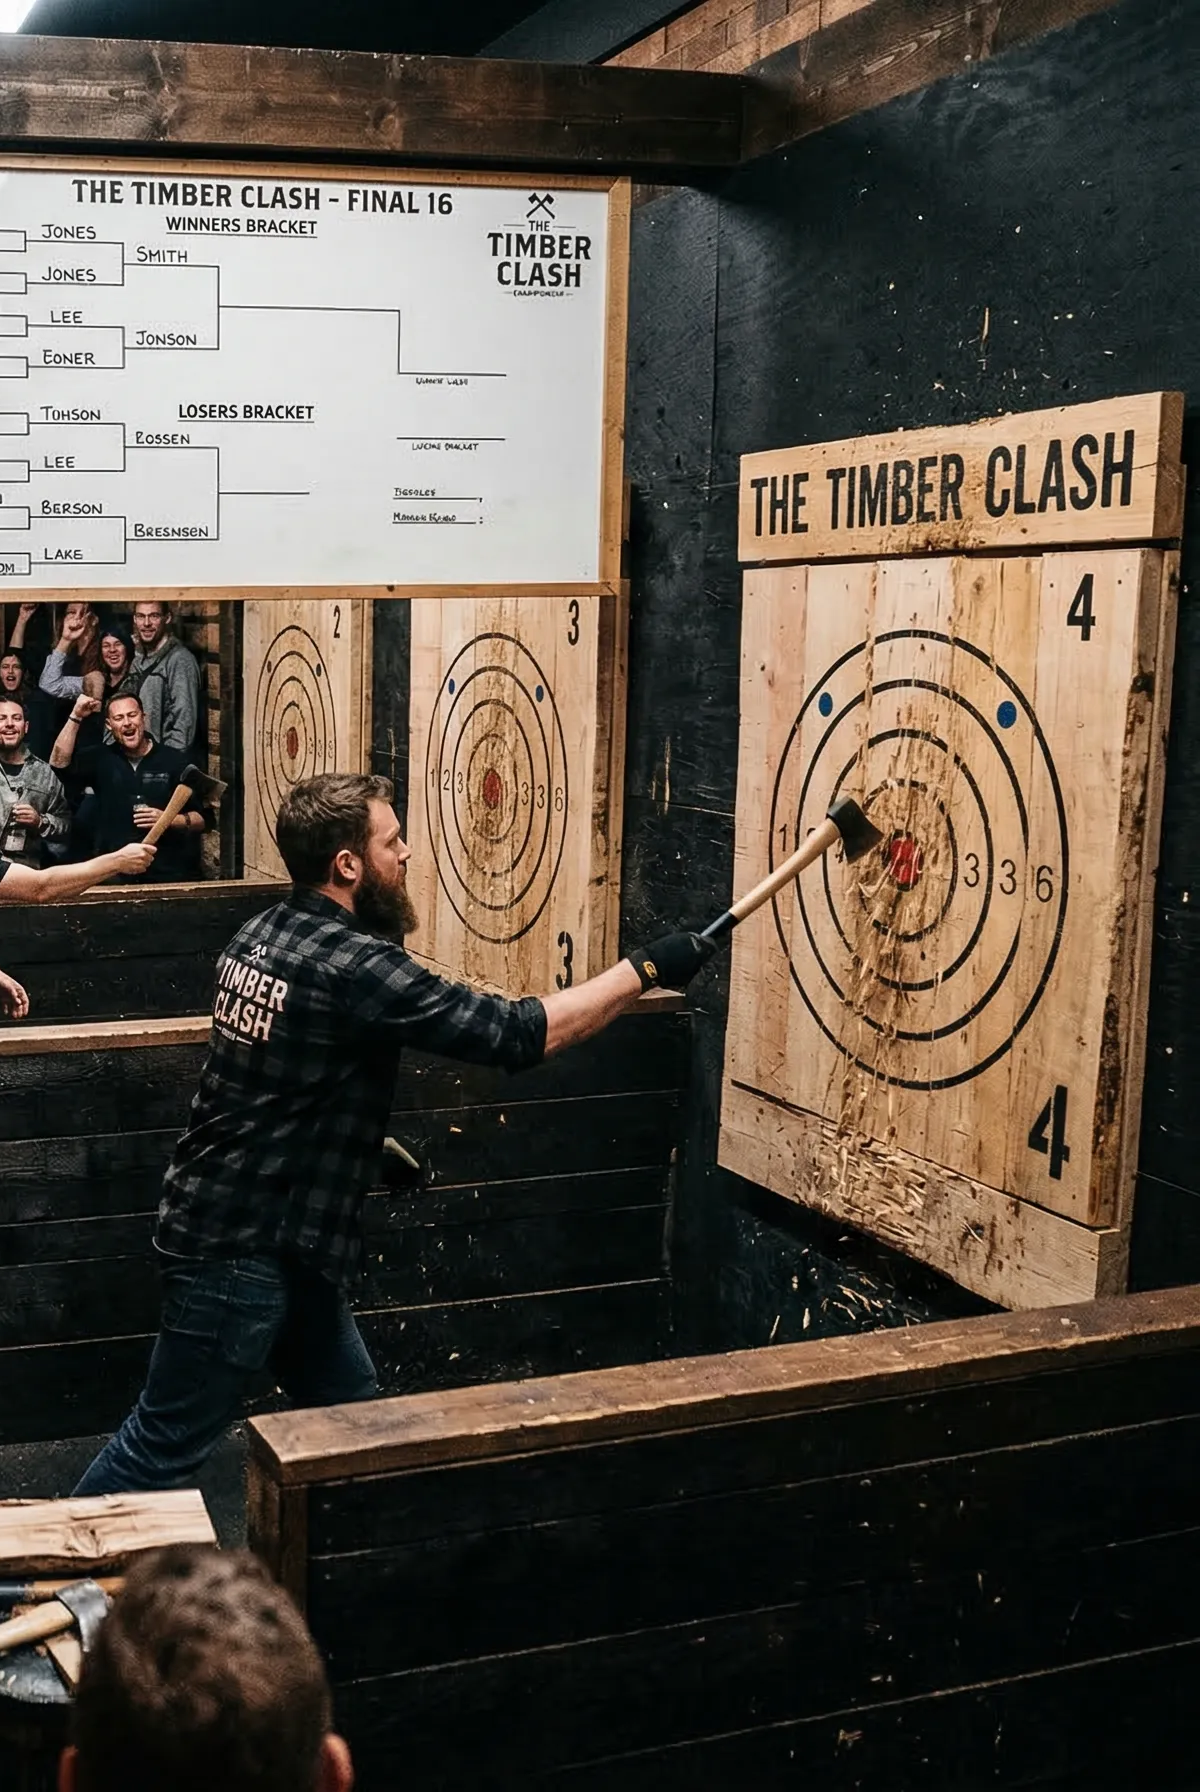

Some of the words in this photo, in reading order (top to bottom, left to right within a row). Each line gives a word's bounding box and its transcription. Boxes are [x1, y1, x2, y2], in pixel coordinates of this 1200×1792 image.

[71, 179, 124, 204] THE
[130, 181, 232, 207] TIMBER
[240, 185, 320, 211] CLASH
[347, 188, 420, 214] FINAL
[427, 192, 453, 215] 16
[41, 224, 97, 240] JONES
[166, 216, 241, 233] WINNERS
[246, 218, 317, 235] BRACKET
[528, 220, 551, 232] THE
[136, 246, 188, 263] SMITH
[487, 232, 592, 260] TIMBER
[41, 266, 97, 282] JONES
[497, 261, 581, 288] CLASH
[50, 310, 83, 324] LEE
[136, 330, 197, 346] JONSON
[178, 404, 238, 419] LOSERS
[243, 404, 315, 420] BRACKET
[43, 455, 76, 469] LEE
[750, 472, 809, 537] THE
[825, 453, 965, 531] TIMBER
[984, 429, 1136, 518] CLASH
[41, 499, 103, 515] BERSON
[43, 547, 84, 561] LAKE
[1066, 573, 1096, 641] 4
[332, 605, 341, 639] 2
[567, 599, 580, 646] 3
[430, 768, 435, 788] 1
[443, 769, 451, 791] 2
[457, 771, 464, 794] 3
[521, 781, 529, 806] 3
[537, 784, 545, 809] 3
[555, 787, 563, 812] 6
[779, 823, 788, 852] 1
[964, 853, 980, 888] 3
[1000, 859, 1017, 896] 3
[1036, 864, 1054, 903] 6
[556, 930, 574, 991] 3
[218, 957, 289, 1013] TIMBER
[214, 990, 275, 1042] CLASH
[1028, 1084, 1070, 1181] 4
